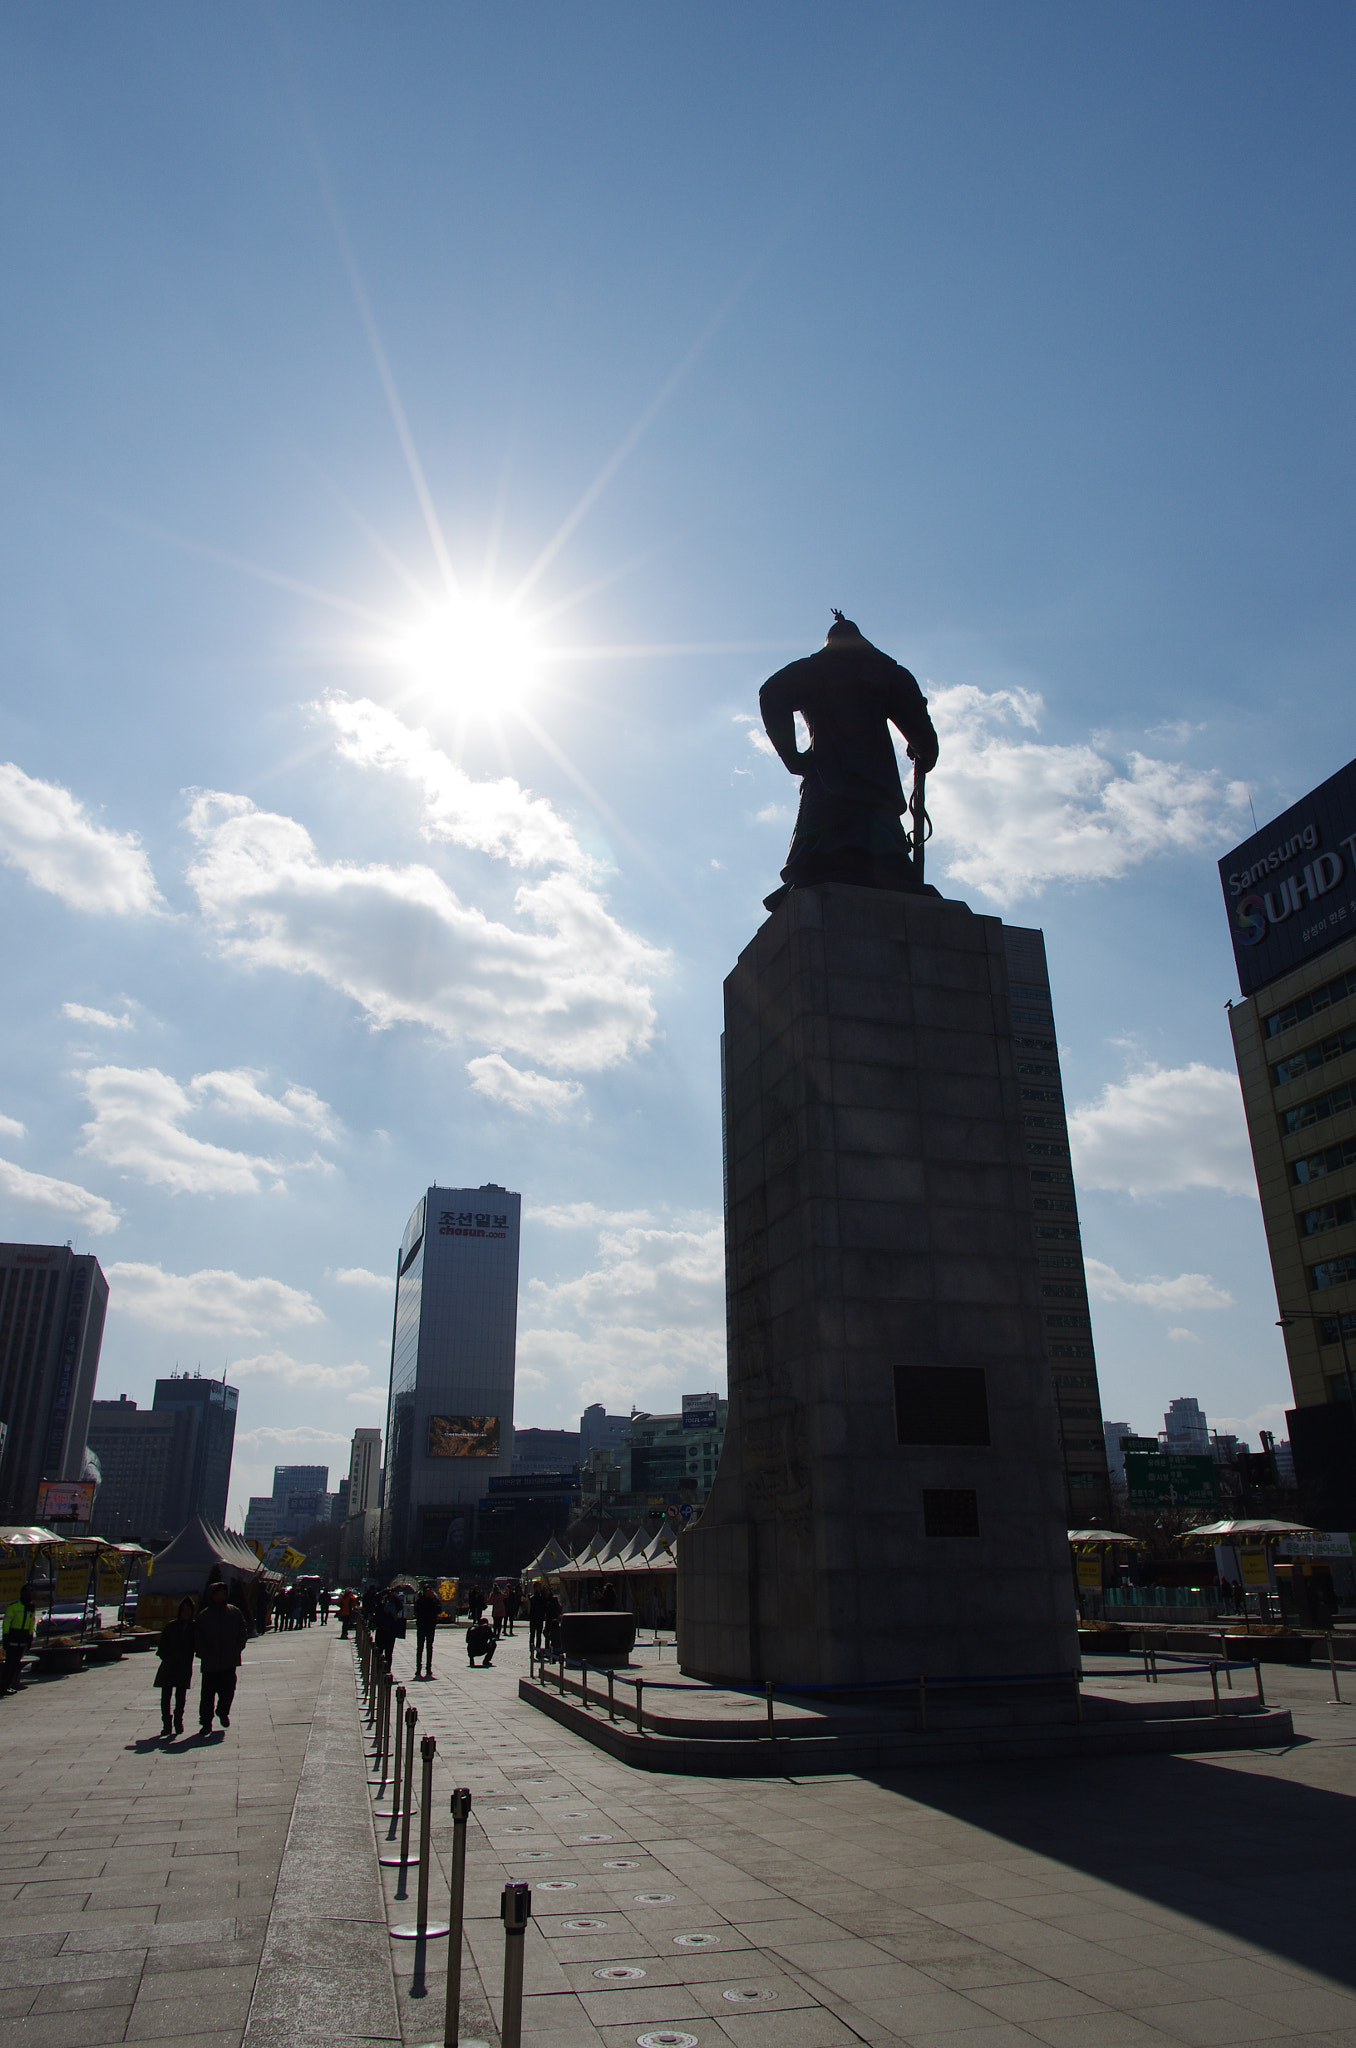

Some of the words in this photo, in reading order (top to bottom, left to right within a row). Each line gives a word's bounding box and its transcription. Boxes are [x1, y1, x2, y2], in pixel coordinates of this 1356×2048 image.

[1229, 823, 1319, 896] Samsung
[1235, 851, 1344, 946] SUHD
[1303, 918, 1327, 942] 삼성이
[1329, 906, 1348, 925] 만든
[438, 1211, 509, 1229] 조선일보
[439, 1226, 506, 1239] chosun.com
